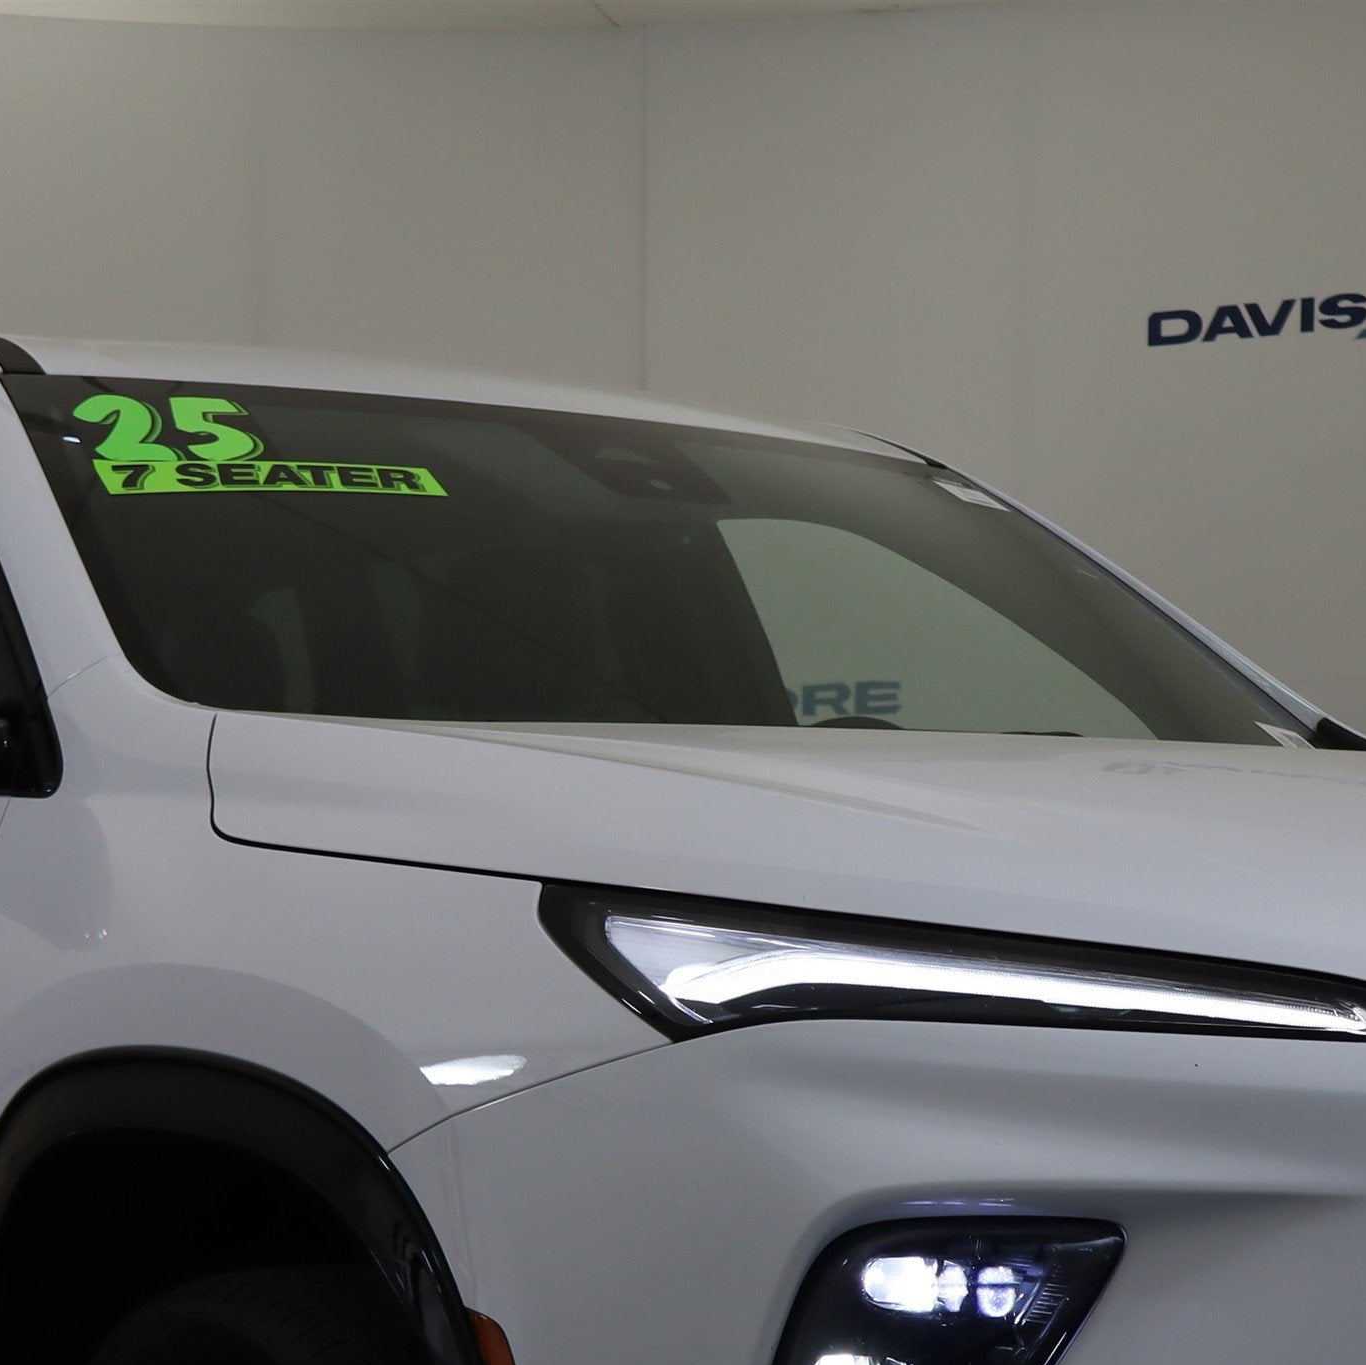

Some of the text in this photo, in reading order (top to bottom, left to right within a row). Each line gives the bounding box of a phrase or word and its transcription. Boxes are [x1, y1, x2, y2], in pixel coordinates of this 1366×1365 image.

[73, 394, 264, 461] 25
[111, 463, 427, 492] 7 SEATER
